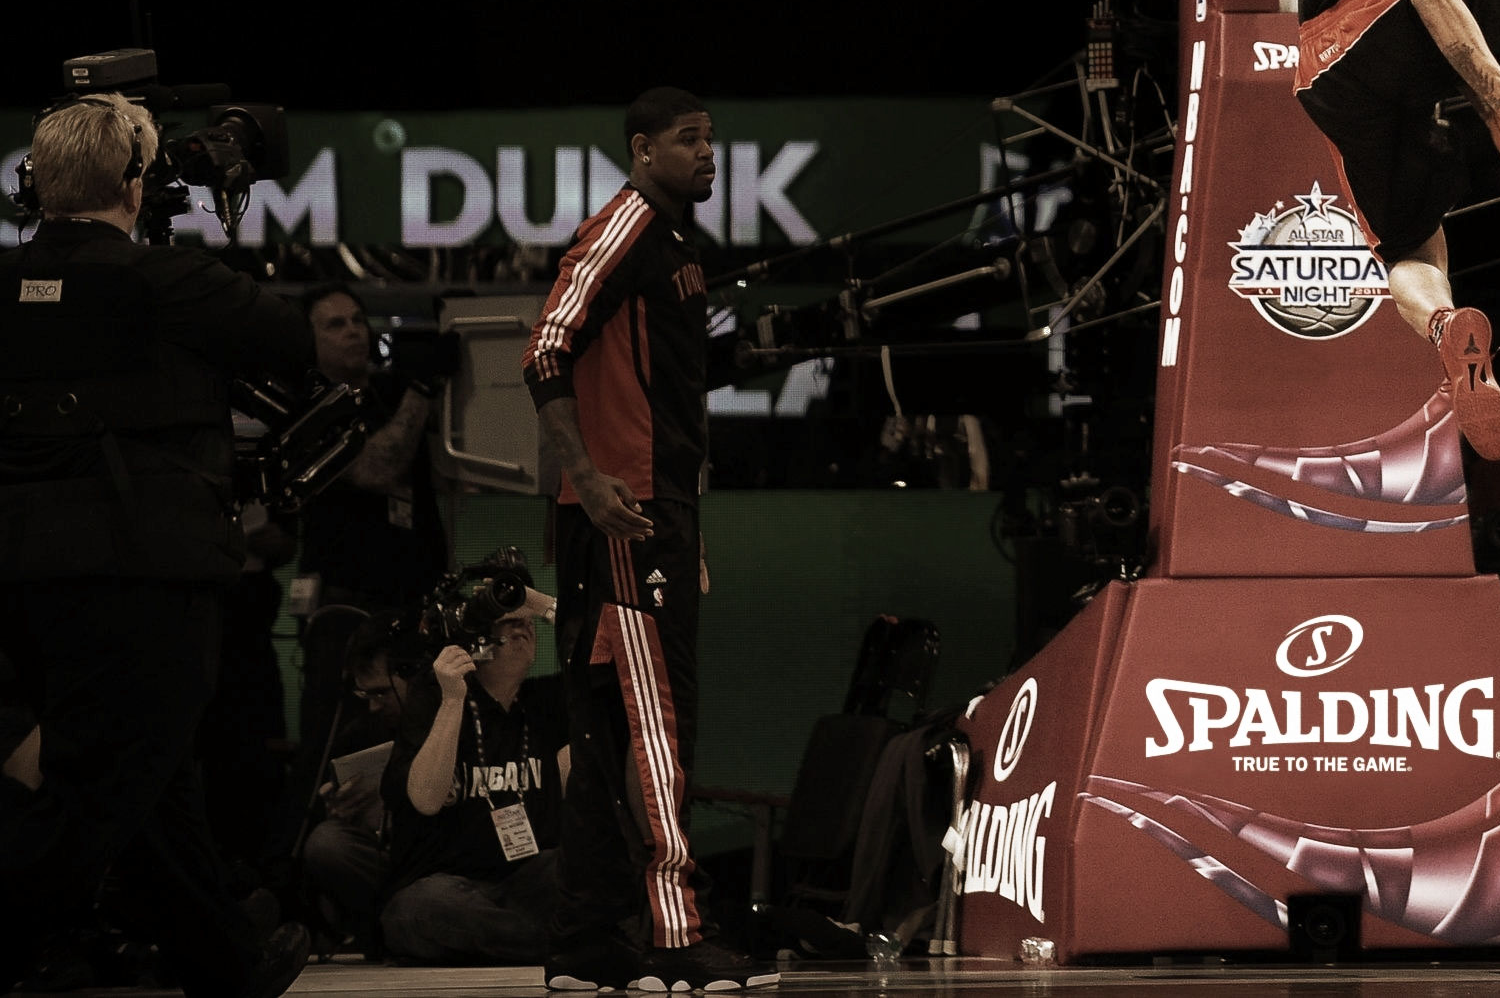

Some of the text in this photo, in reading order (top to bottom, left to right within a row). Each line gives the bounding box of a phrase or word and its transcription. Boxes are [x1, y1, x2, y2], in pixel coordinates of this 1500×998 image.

[25, 285, 56, 297] PRO
[1283, 286, 1351, 303] NIGHT
[1145, 676, 1495, 759] SPALDING
[1232, 756, 1279, 772] TRUE
[1285, 756, 1308, 772] TO
[1315, 756, 1348, 772] THE
